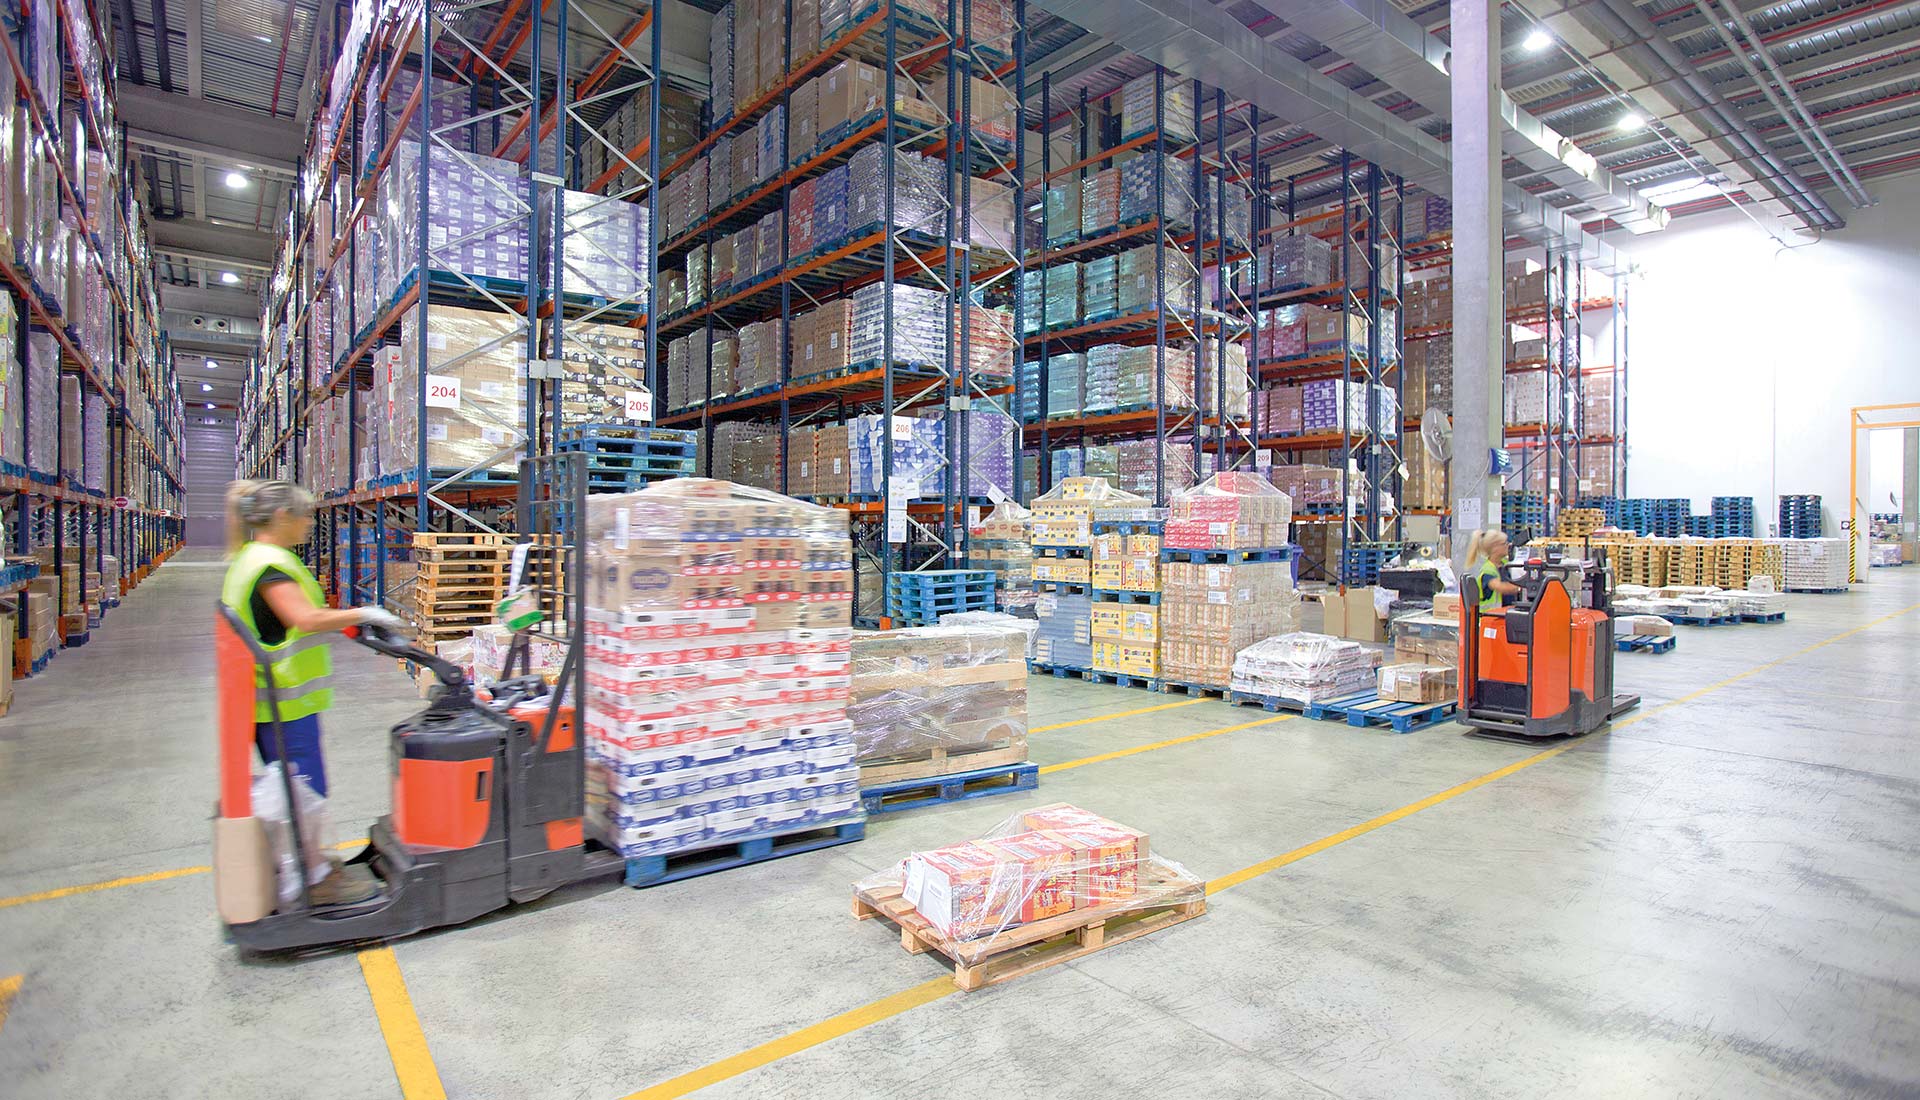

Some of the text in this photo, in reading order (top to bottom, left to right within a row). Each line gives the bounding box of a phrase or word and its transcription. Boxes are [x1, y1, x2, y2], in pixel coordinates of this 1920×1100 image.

[431, 385, 457, 399] 204
[629, 400, 649, 412] 205
[896, 424, 910, 434] 206
